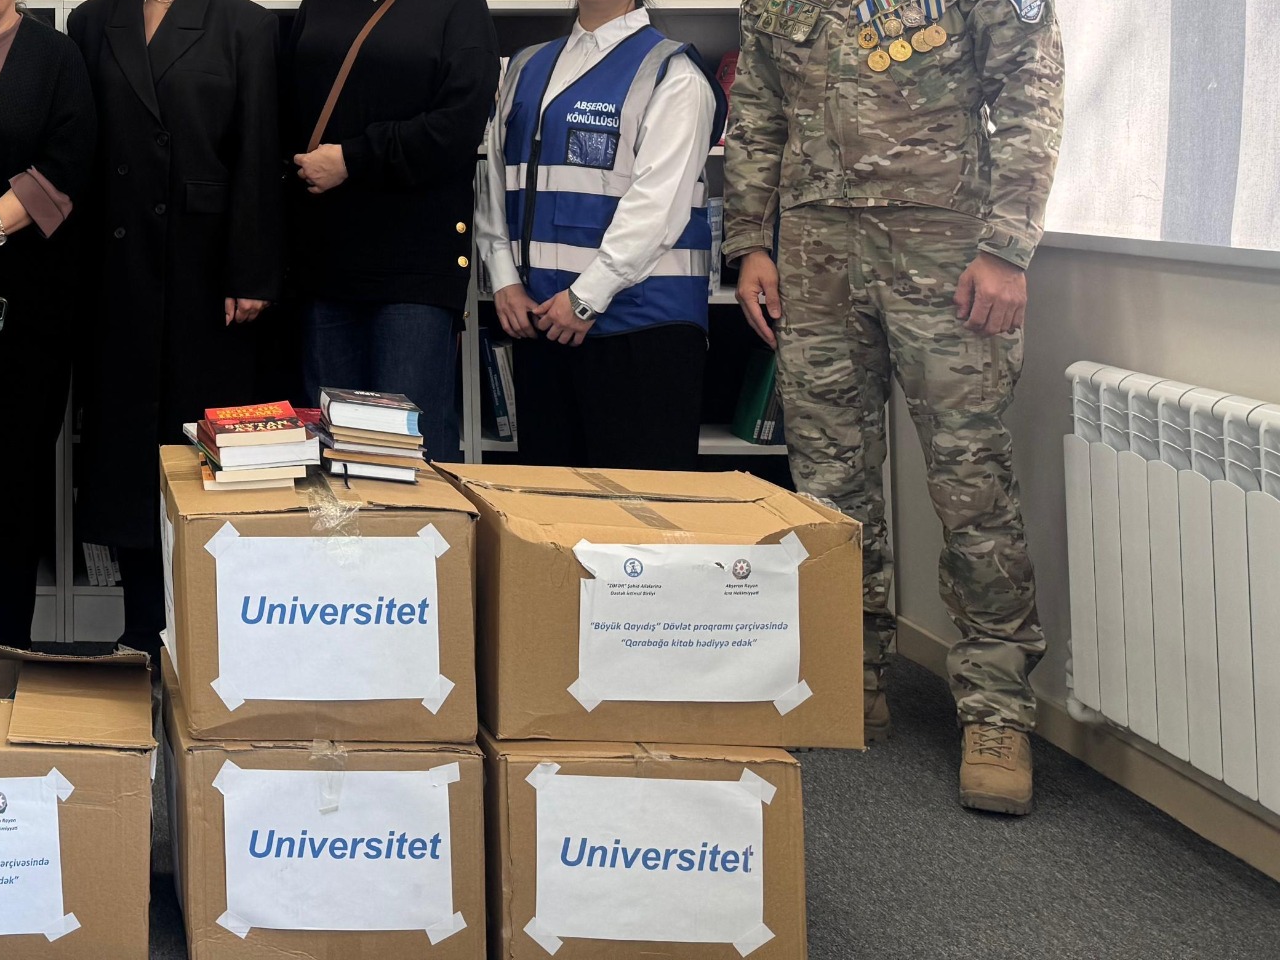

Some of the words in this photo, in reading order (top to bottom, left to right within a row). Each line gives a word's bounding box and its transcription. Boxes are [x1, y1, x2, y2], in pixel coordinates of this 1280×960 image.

[574, 101, 615, 113] ABŞERON
[566, 112, 619, 127] KÖNÜLLÜSÜ
[241, 595, 429, 626] Universitet
[663, 622, 691, 631] Dövlət
[693, 623, 733, 632] proqramı
[735, 622, 788, 632] çərçivəsində
[671, 638, 694, 648] kitab
[696, 638, 729, 649] hədiyyə
[249, 829, 442, 860] Universitet
[560, 837, 754, 873] Universitet
